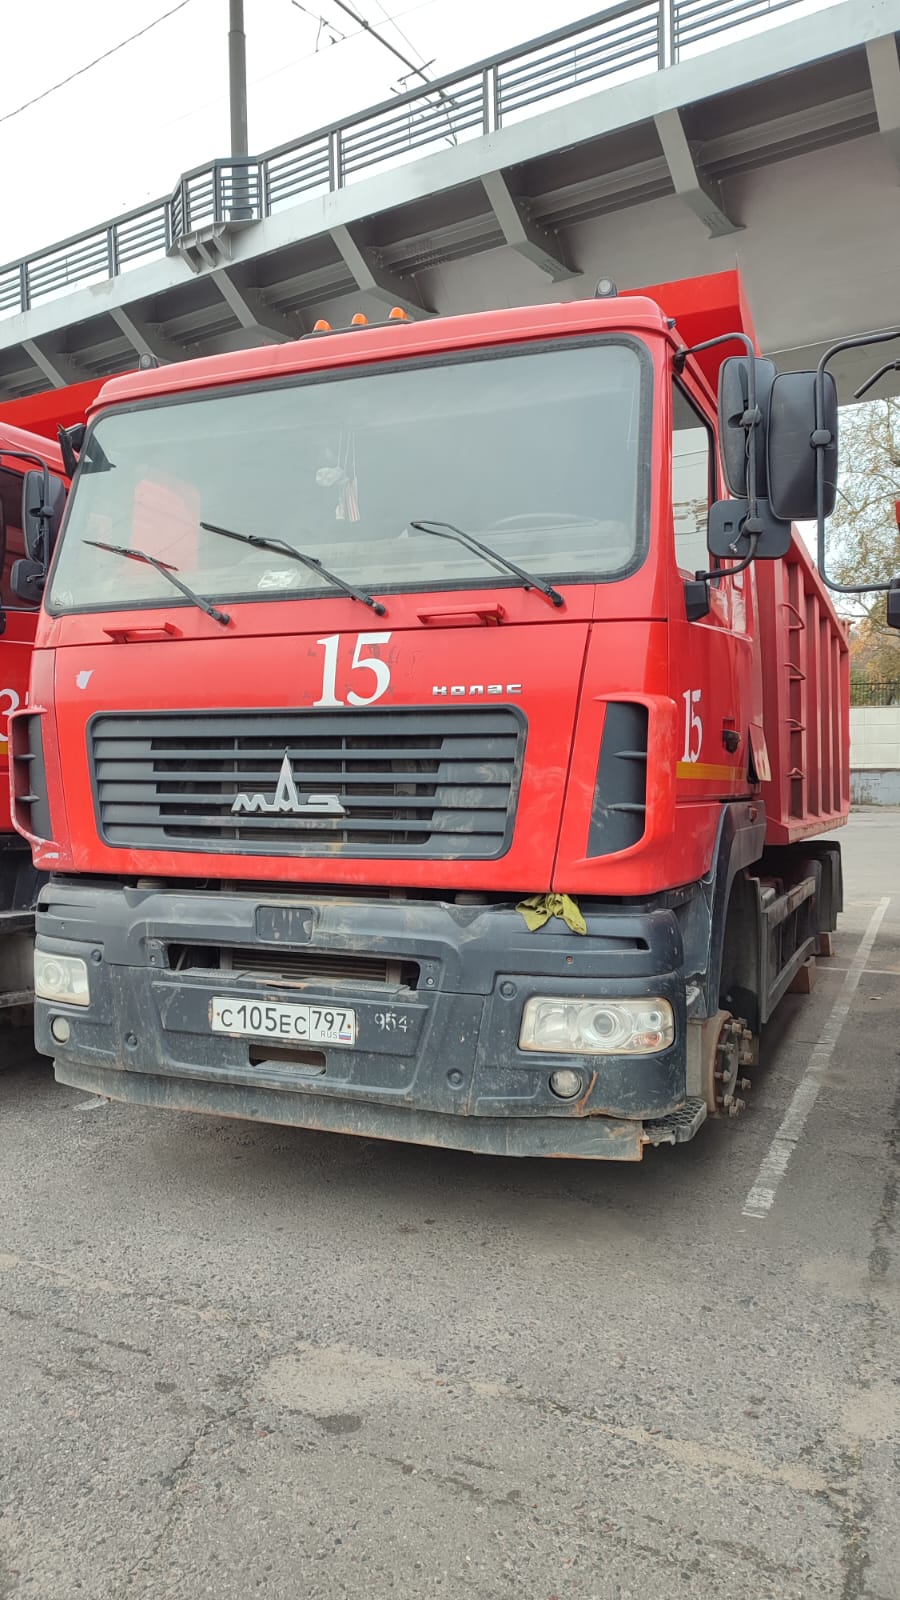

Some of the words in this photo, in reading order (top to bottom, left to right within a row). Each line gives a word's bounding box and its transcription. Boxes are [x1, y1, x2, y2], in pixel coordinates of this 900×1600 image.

[313, 632, 392, 706] 15
[681, 689, 703, 763] 15
[320, 1030, 339, 1040] RUS
[374, 1013, 408, 1033] 954
